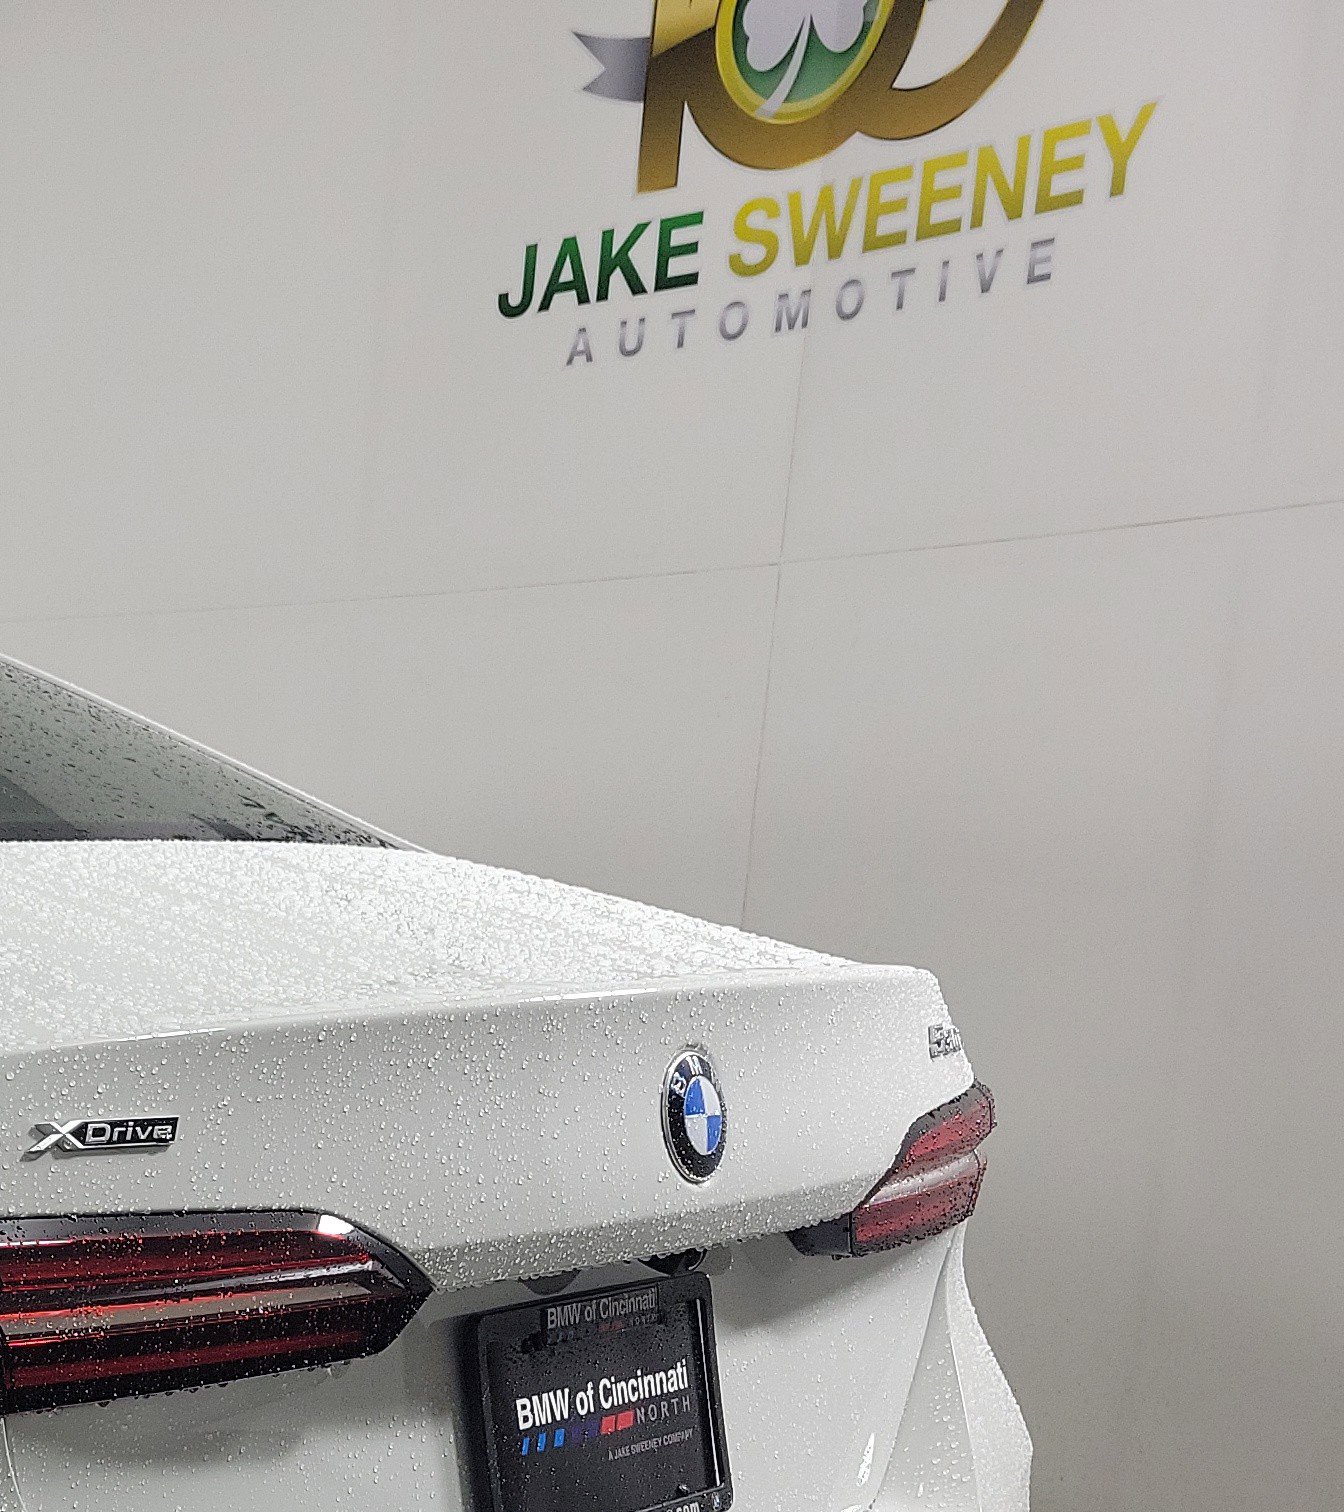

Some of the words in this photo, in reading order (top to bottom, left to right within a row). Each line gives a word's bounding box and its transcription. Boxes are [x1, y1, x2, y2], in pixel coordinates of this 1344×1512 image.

[497, 210, 705, 320] JAKE
[727, 100, 1161, 279] SWEENEY
[565, 236, 1057, 367] AUTOMOTIVE
[546, 1303, 582, 1330] BMW
[584, 1299, 597, 1323] of
[599, 1286, 657, 1320] Cincinnati
[515, 1387, 570, 1431] BMW
[575, 1381, 595, 1416] of
[598, 1357, 690, 1411] Cincinnati
[635, 1393, 692, 1425] NORTH
[614, 1444, 630, 1460] JAKE
